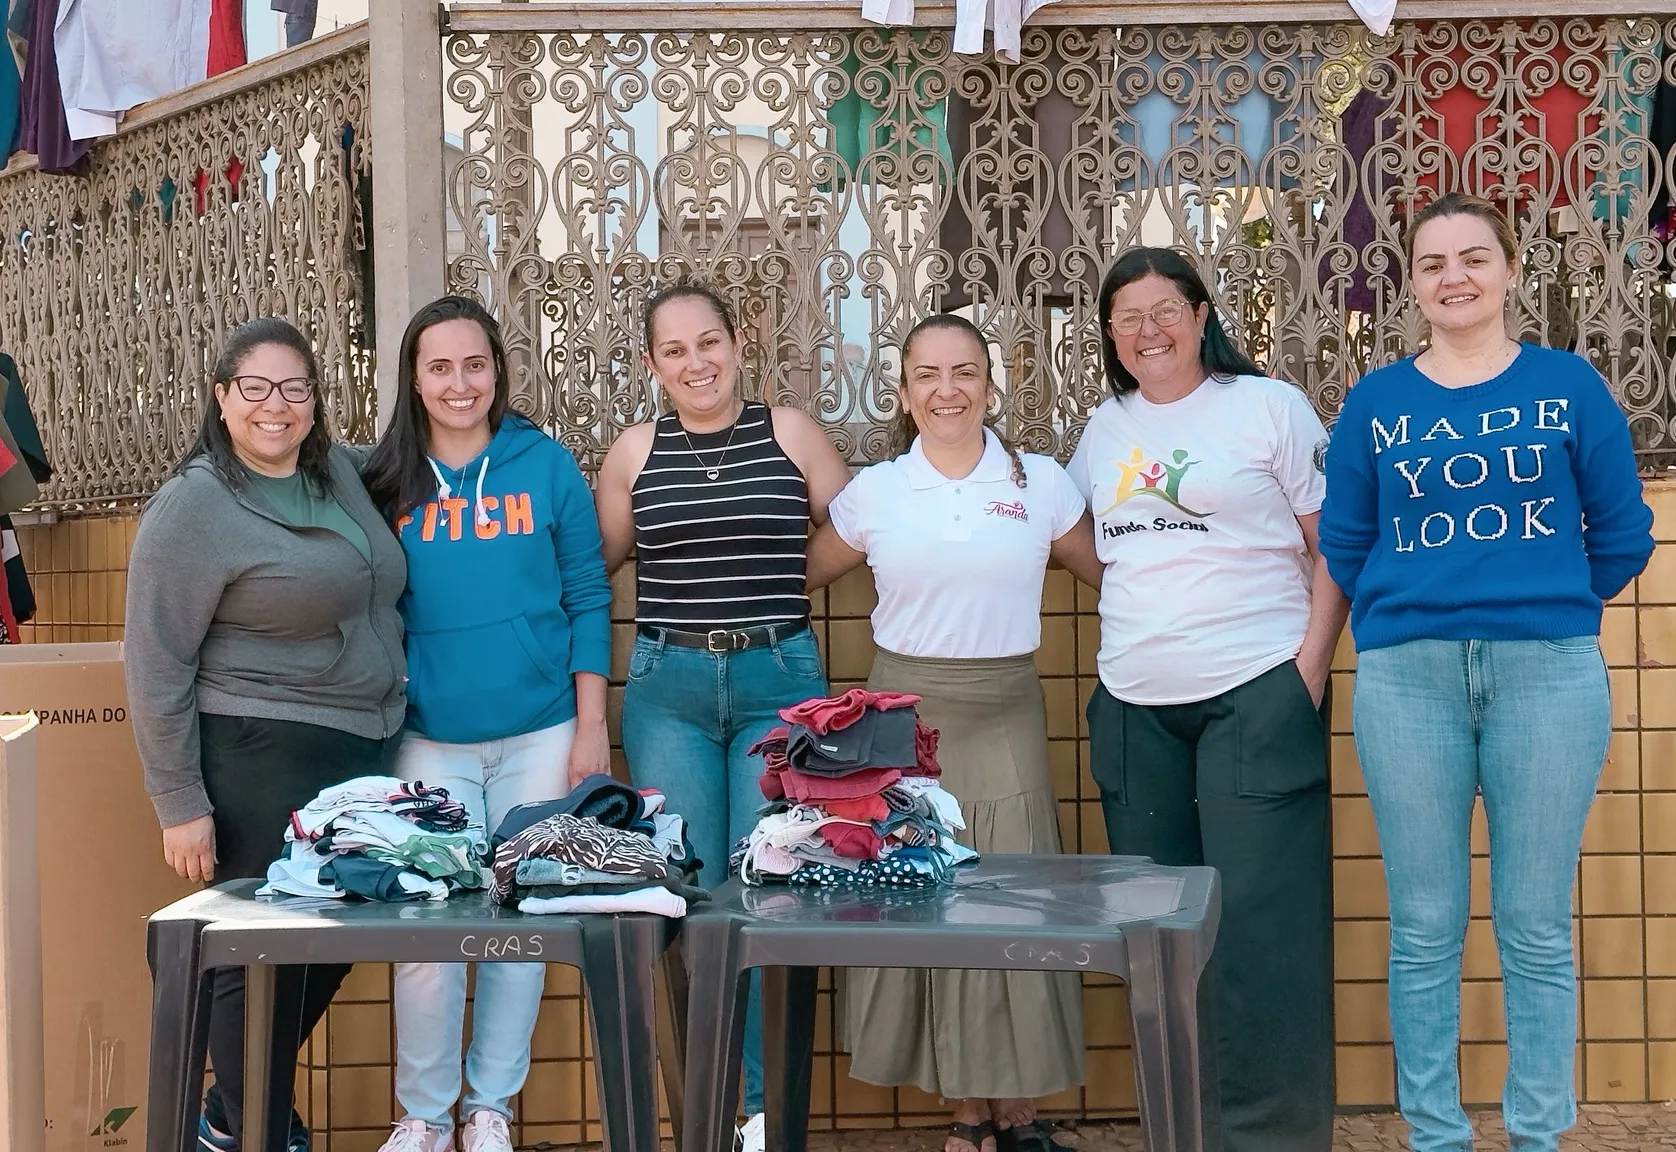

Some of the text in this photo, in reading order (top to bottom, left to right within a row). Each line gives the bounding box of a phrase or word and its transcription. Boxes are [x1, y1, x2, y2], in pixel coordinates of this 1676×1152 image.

[1371, 398, 1571, 454] MADE
[1394, 443, 1548, 499] YOU
[396, 492, 535, 542] ITCH
[983, 500, 1030, 522] Aranda
[1393, 496, 1556, 553] LOOK
[2, 707, 126, 725] PANHA DO
[460, 934, 543, 958] CRAS
[103, 1138, 128, 1147] Klabin
